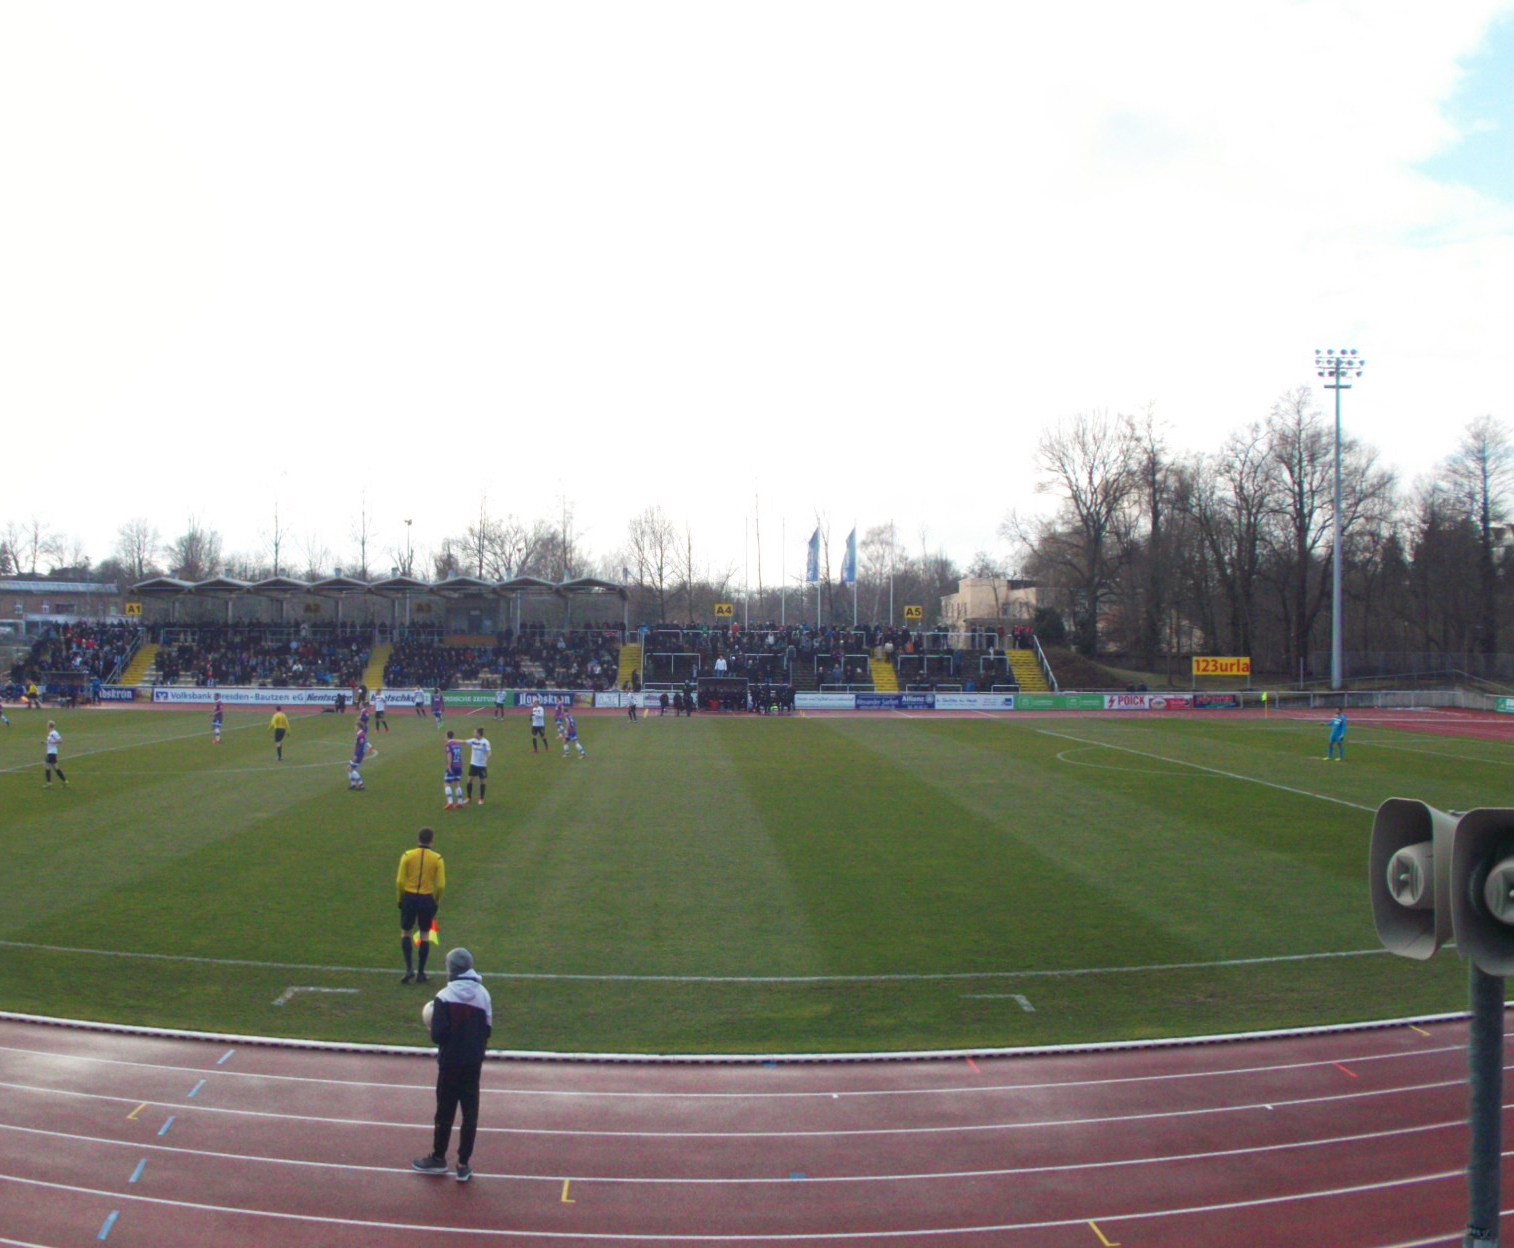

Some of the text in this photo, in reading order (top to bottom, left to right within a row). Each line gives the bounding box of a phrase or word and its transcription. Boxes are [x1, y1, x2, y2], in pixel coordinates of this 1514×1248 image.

[127, 604, 141, 614] A1
[716, 605, 732, 615] A4
[906, 607, 921, 616] A5
[99, 689, 133, 699] dskron
[170, 690, 212, 700] Volksbank
[1117, 695, 1145, 706] POICK
